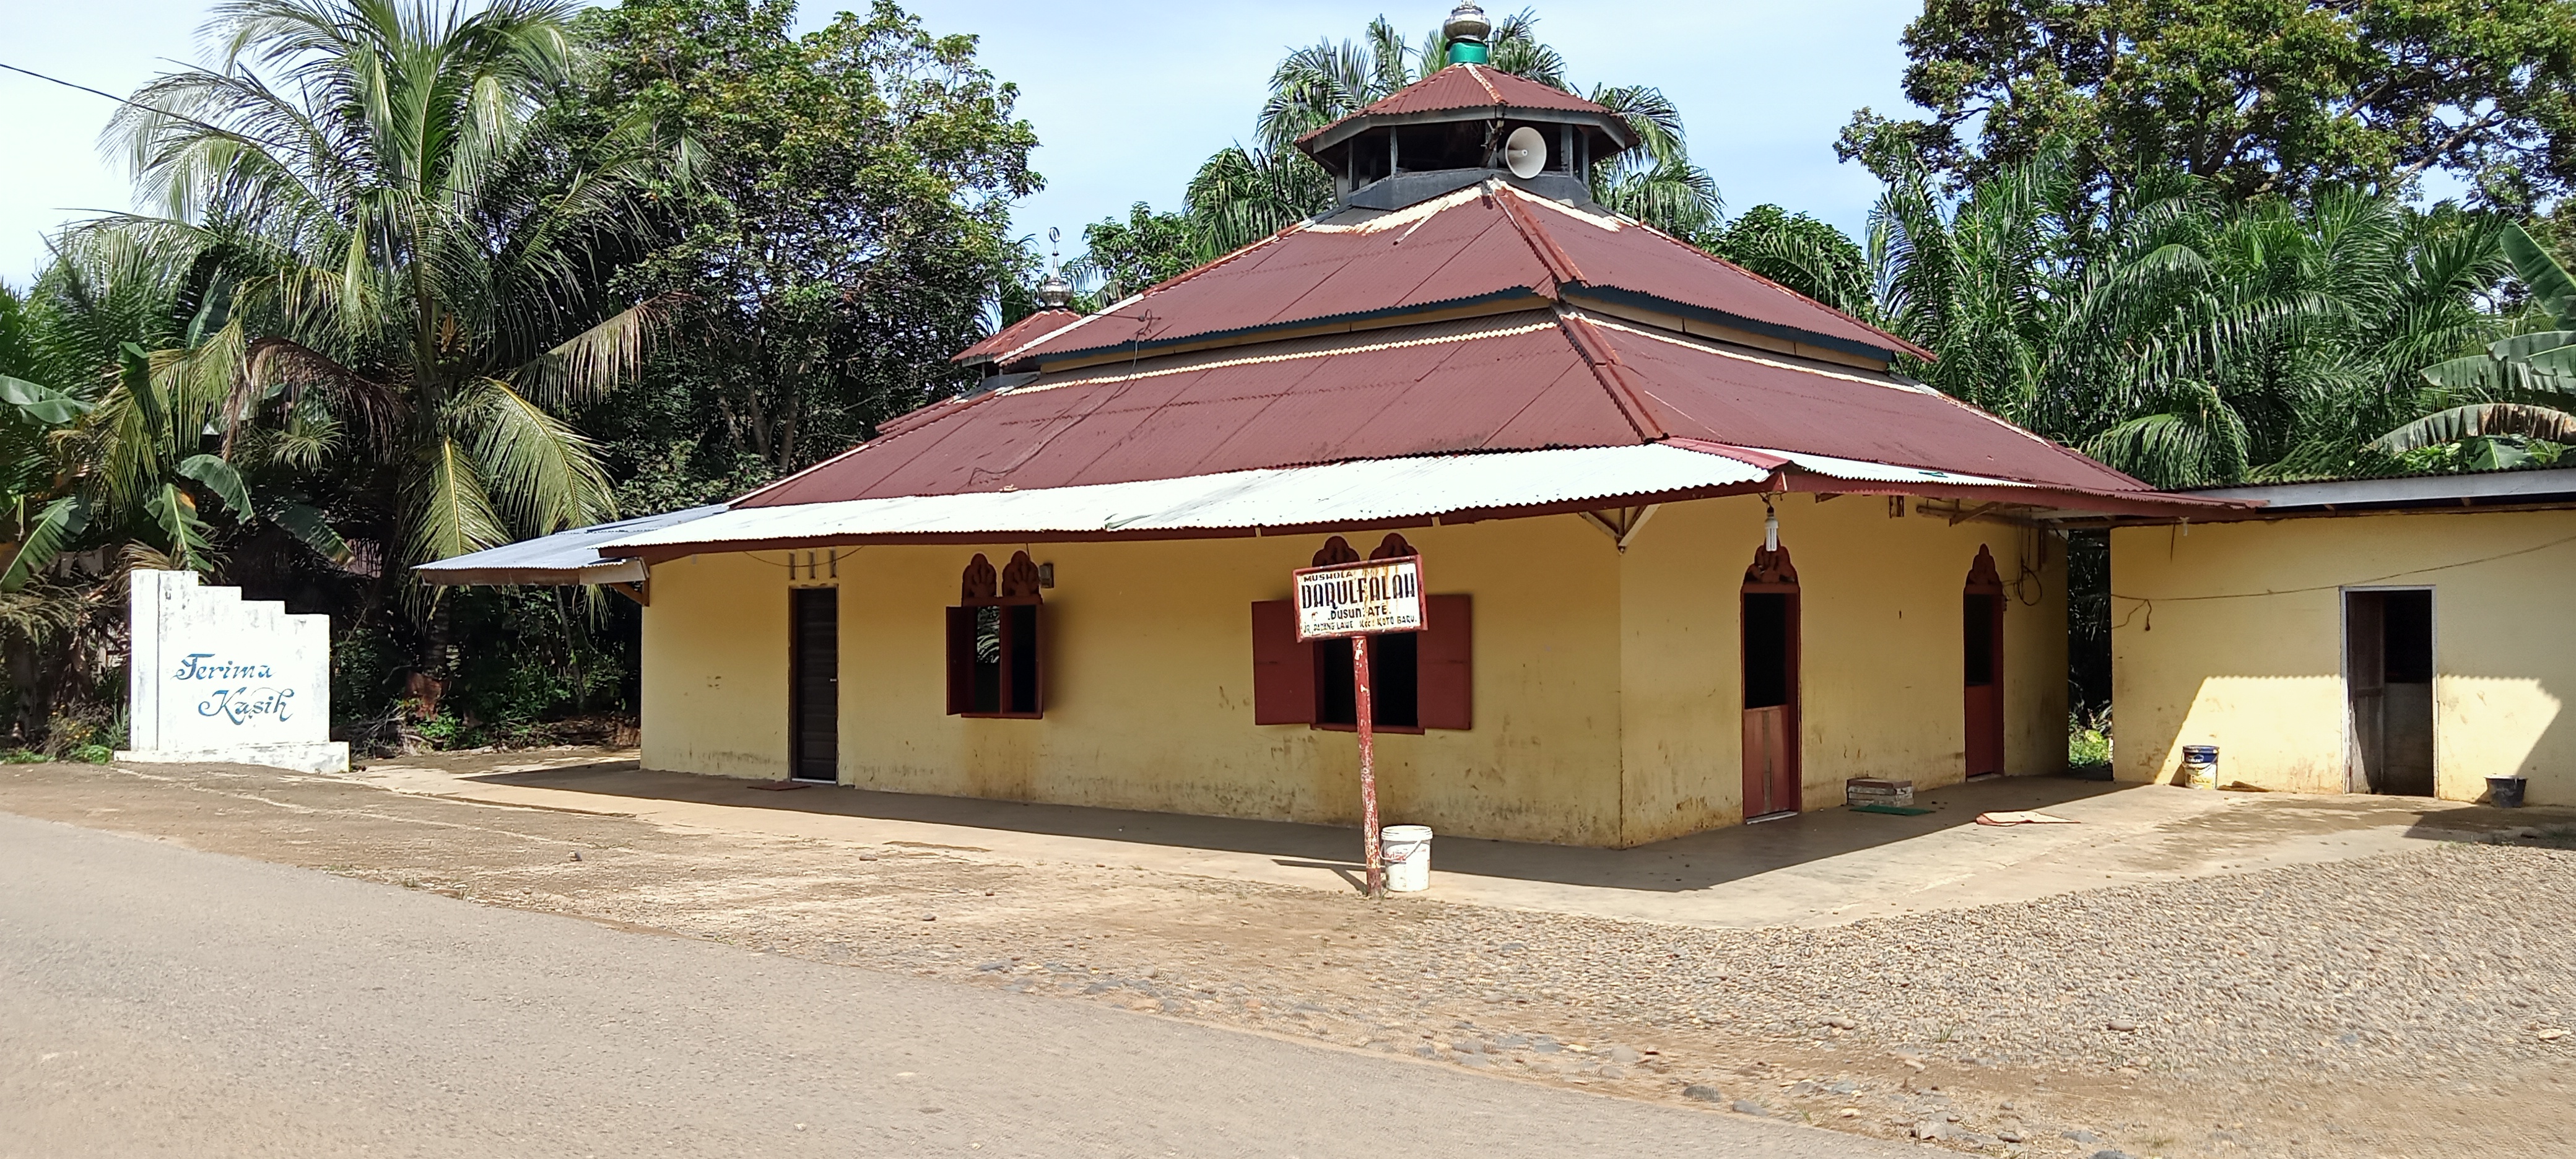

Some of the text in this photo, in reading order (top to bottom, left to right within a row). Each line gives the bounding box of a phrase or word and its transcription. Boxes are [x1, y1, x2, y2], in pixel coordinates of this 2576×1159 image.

[1303, 571, 1353, 582] MUSHOLA
[1302, 573, 1416, 609] DARULFALAH
[1377, 616, 1394, 627] KOTO
[170, 654, 276, 680] Terima
[198, 687, 295, 726] Kasih
